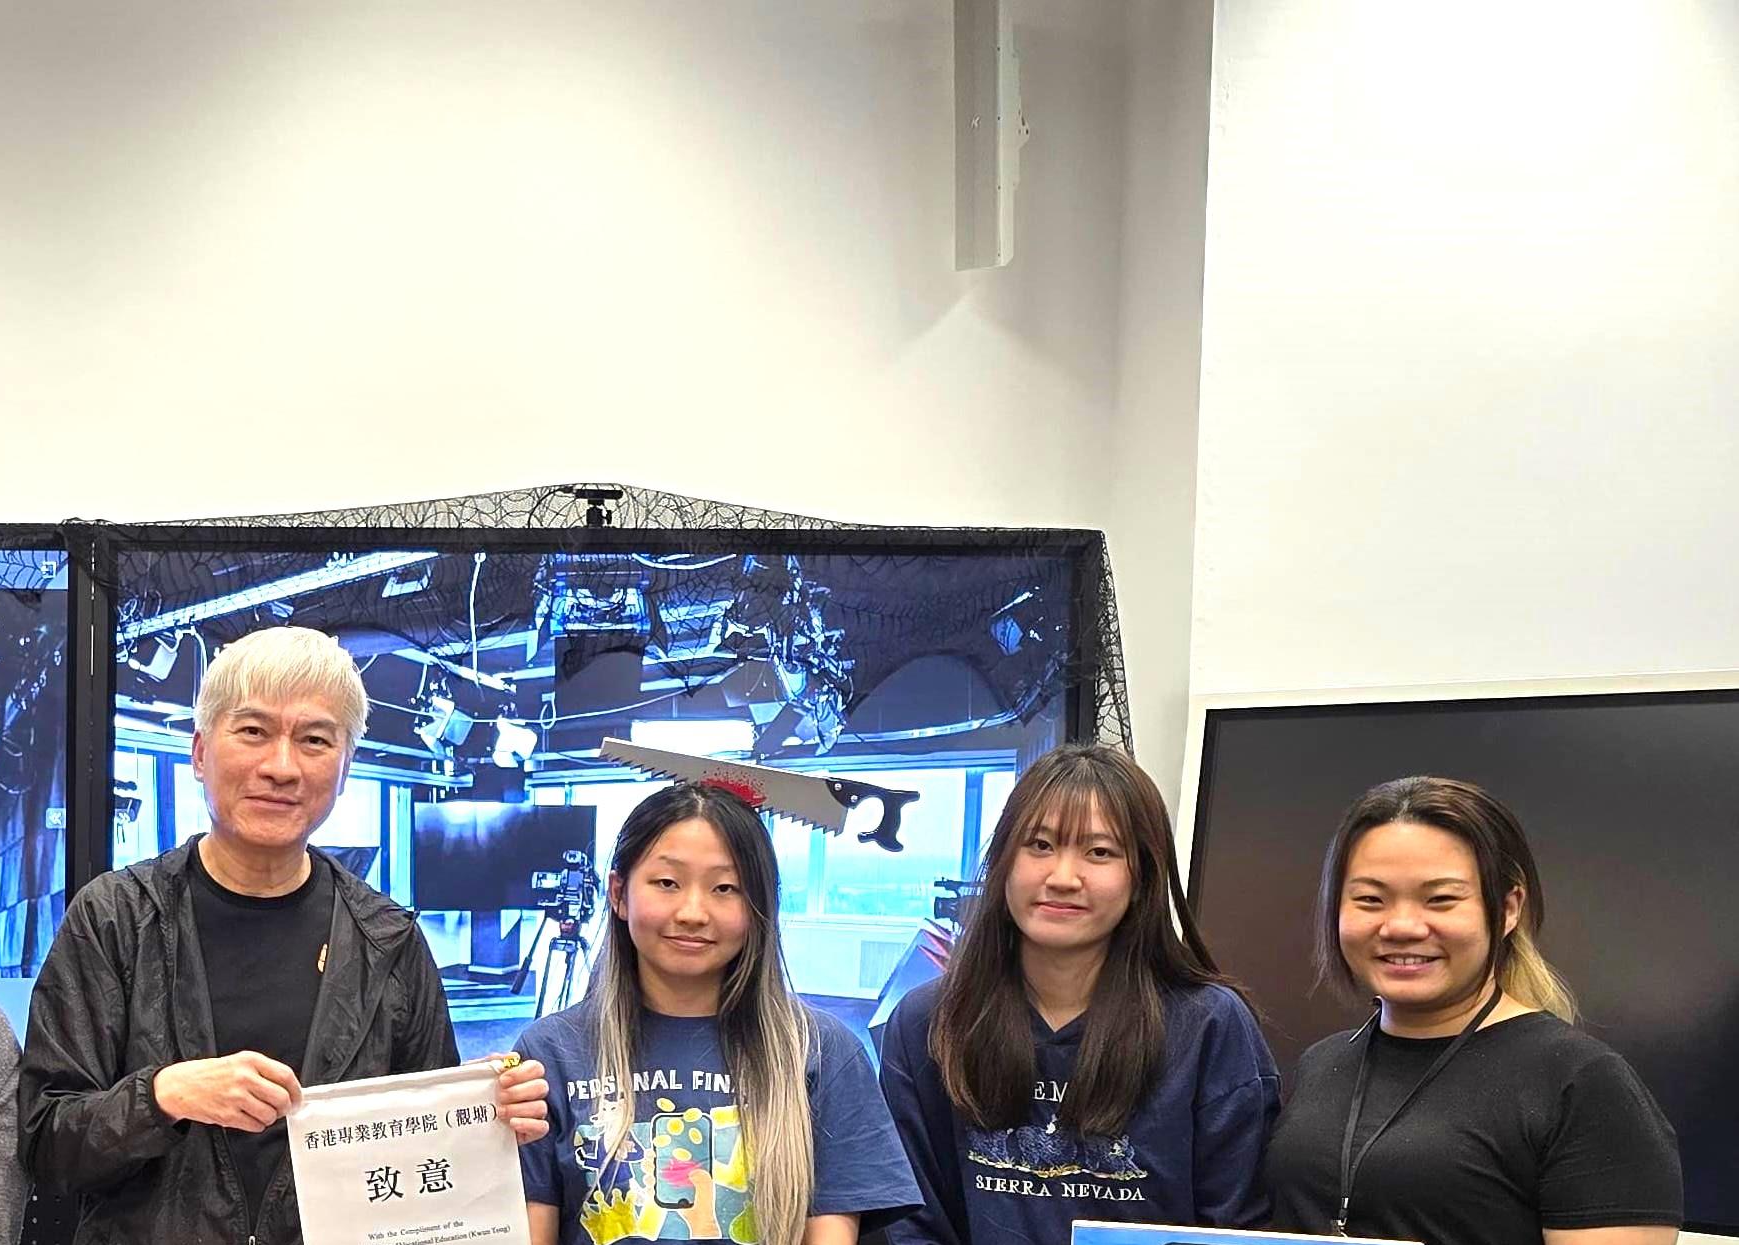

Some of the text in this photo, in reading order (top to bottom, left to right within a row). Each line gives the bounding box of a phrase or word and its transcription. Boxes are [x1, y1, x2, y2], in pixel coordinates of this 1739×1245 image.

[567, 1069, 736, 1102] PERSNAL FIN
[364, 1158, 454, 1203] 致意
[975, 1174, 1146, 1201] SIERRA NEVADA
[435, 1231, 467, 1244] Education
[443, 1222, 451, 1230] of
